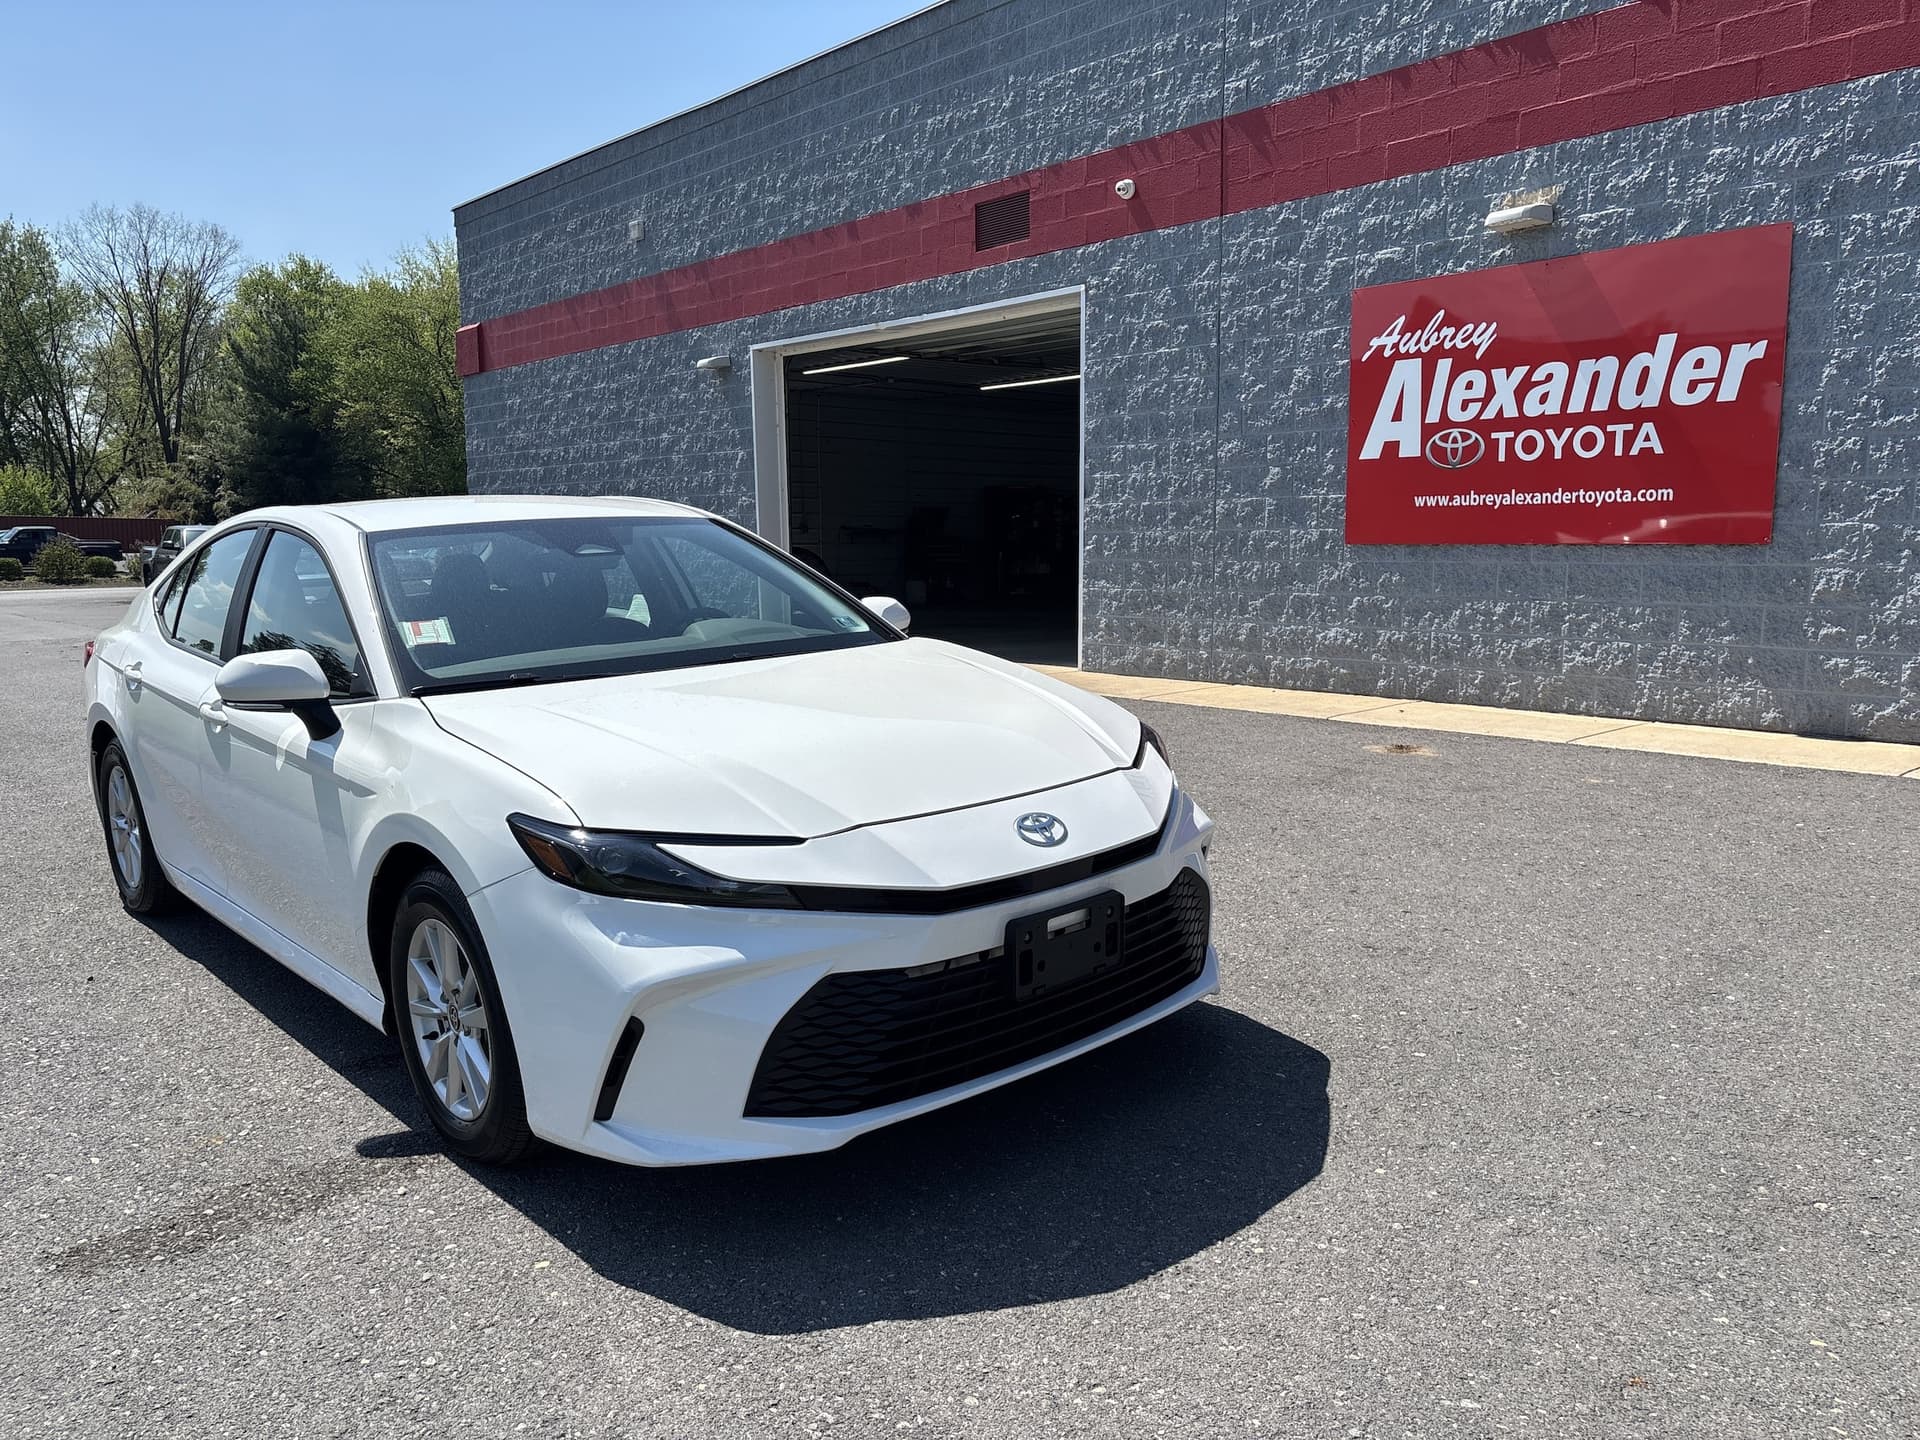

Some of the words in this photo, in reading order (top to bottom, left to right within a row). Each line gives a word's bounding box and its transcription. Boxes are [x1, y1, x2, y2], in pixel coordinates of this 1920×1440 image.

[1361, 308, 1499, 362] Aubrey
[1358, 332, 1769, 461] Alexander
[1490, 421, 1665, 463] TOYOTA
[1413, 486, 1675, 510] www.aubreyalexandertoyota.com
